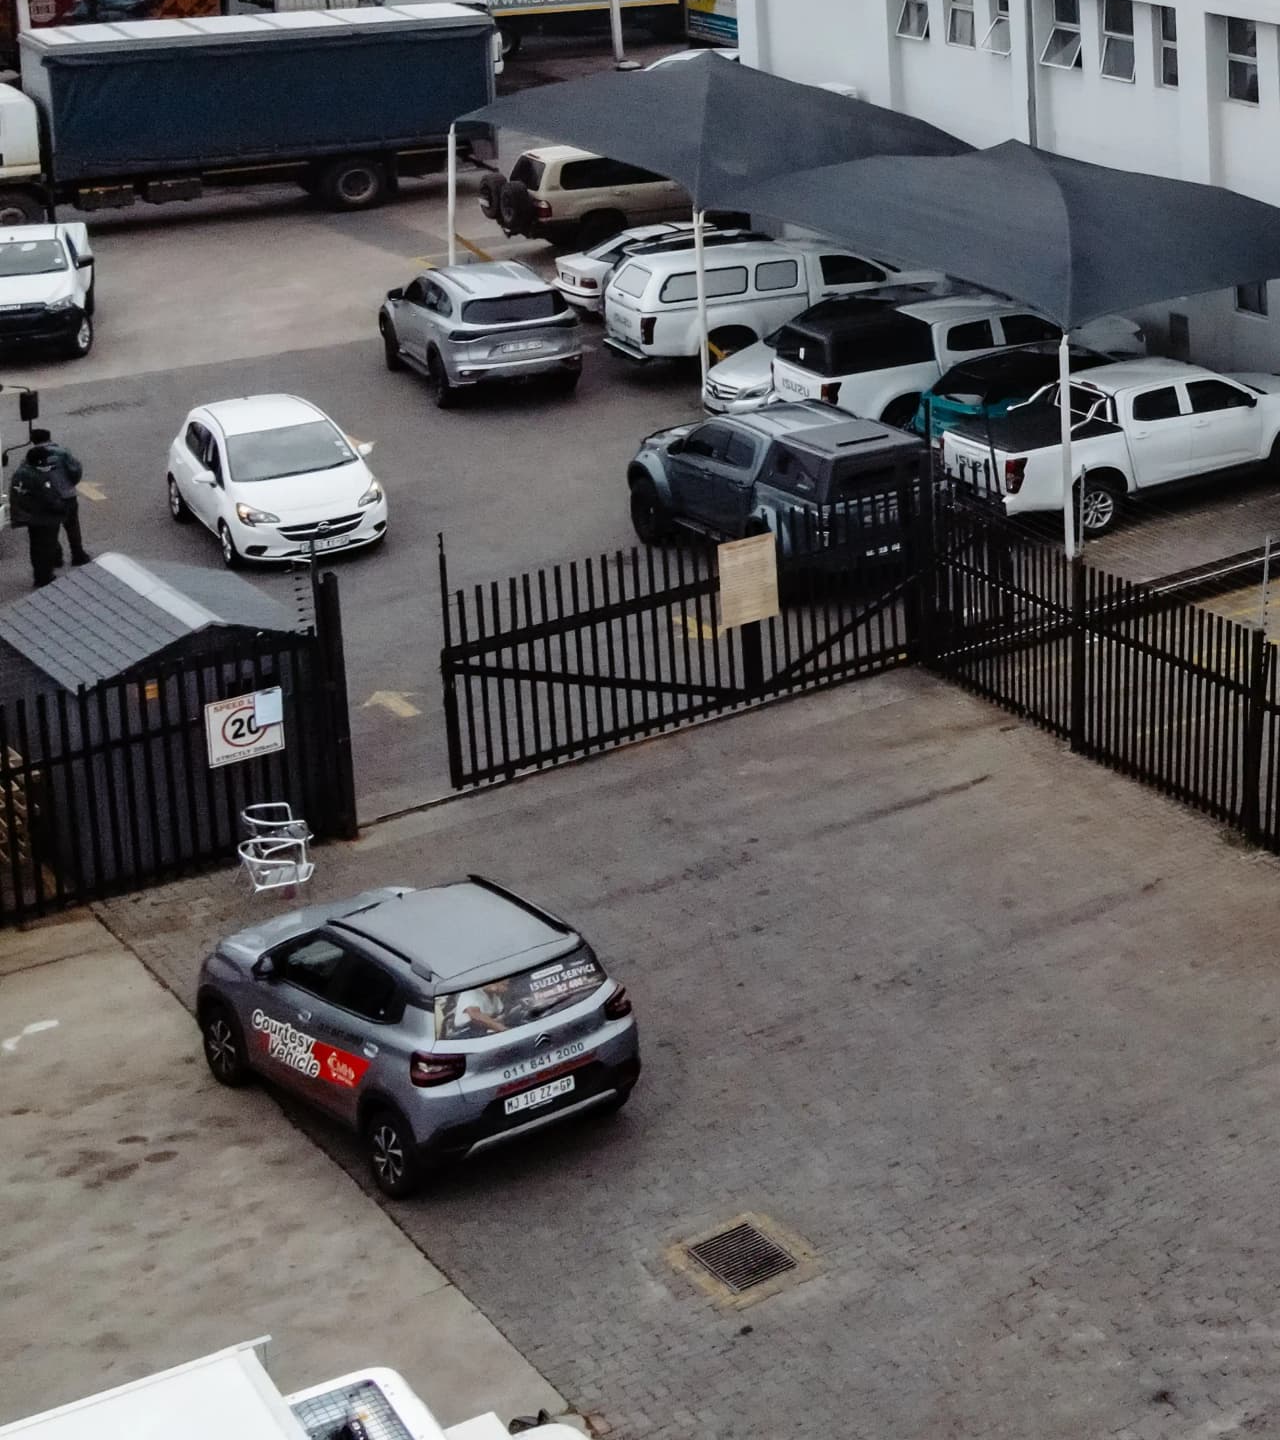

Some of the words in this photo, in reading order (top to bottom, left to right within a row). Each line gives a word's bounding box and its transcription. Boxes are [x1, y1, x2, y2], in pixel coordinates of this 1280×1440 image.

[213, 700, 245, 713] SPEED
[529, 974, 560, 993] ISUZU
[560, 962, 596, 980] SERVICE
[252, 1008, 315, 1056] Courtesy
[269, 1037, 321, 1078] Vehicle
[503, 1063, 526, 1080] 011
[530, 1054, 552, 1070] 841
[555, 1042, 585, 1060] 2000
